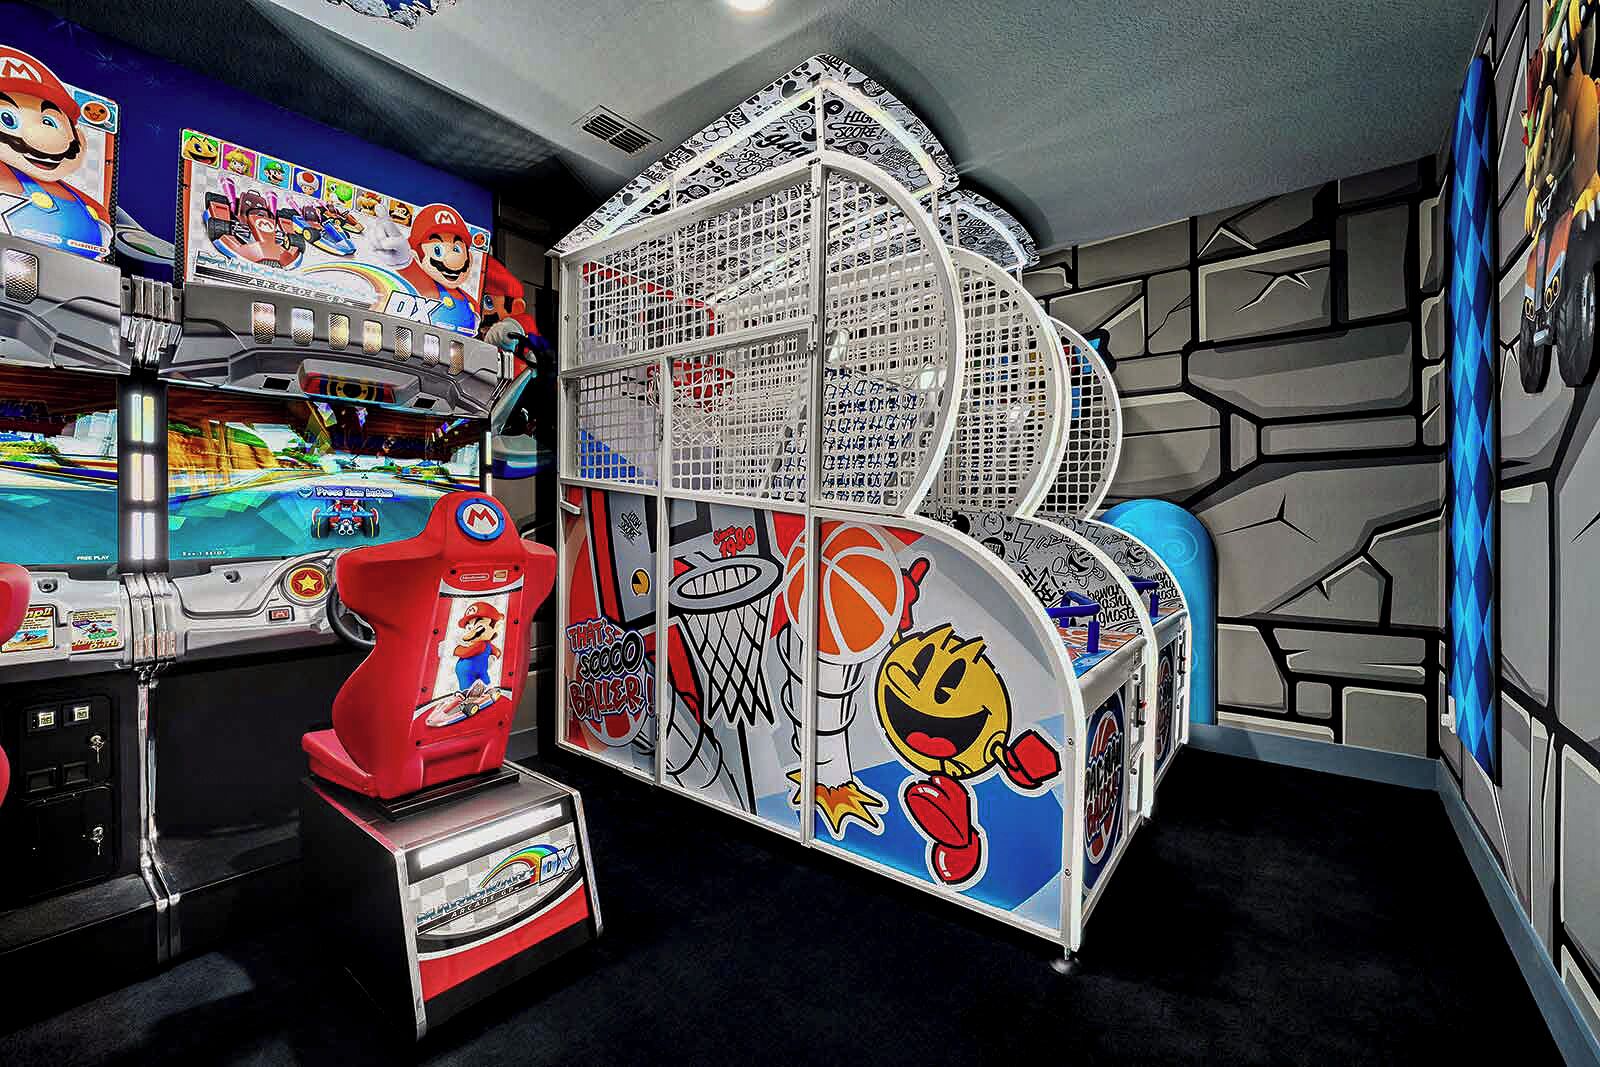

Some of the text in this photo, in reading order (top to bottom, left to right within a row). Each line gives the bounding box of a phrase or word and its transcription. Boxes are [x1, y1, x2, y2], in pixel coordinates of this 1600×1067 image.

[834, 127, 884, 139] SCORE!
[384, 290, 441, 325] DX
[719, 525, 755, 560] 1980
[567, 618, 614, 652] THAT'S
[569, 674, 656, 721] BALLER!
[539, 844, 575, 885] DX
[451, 894, 496, 918] ARCADE
